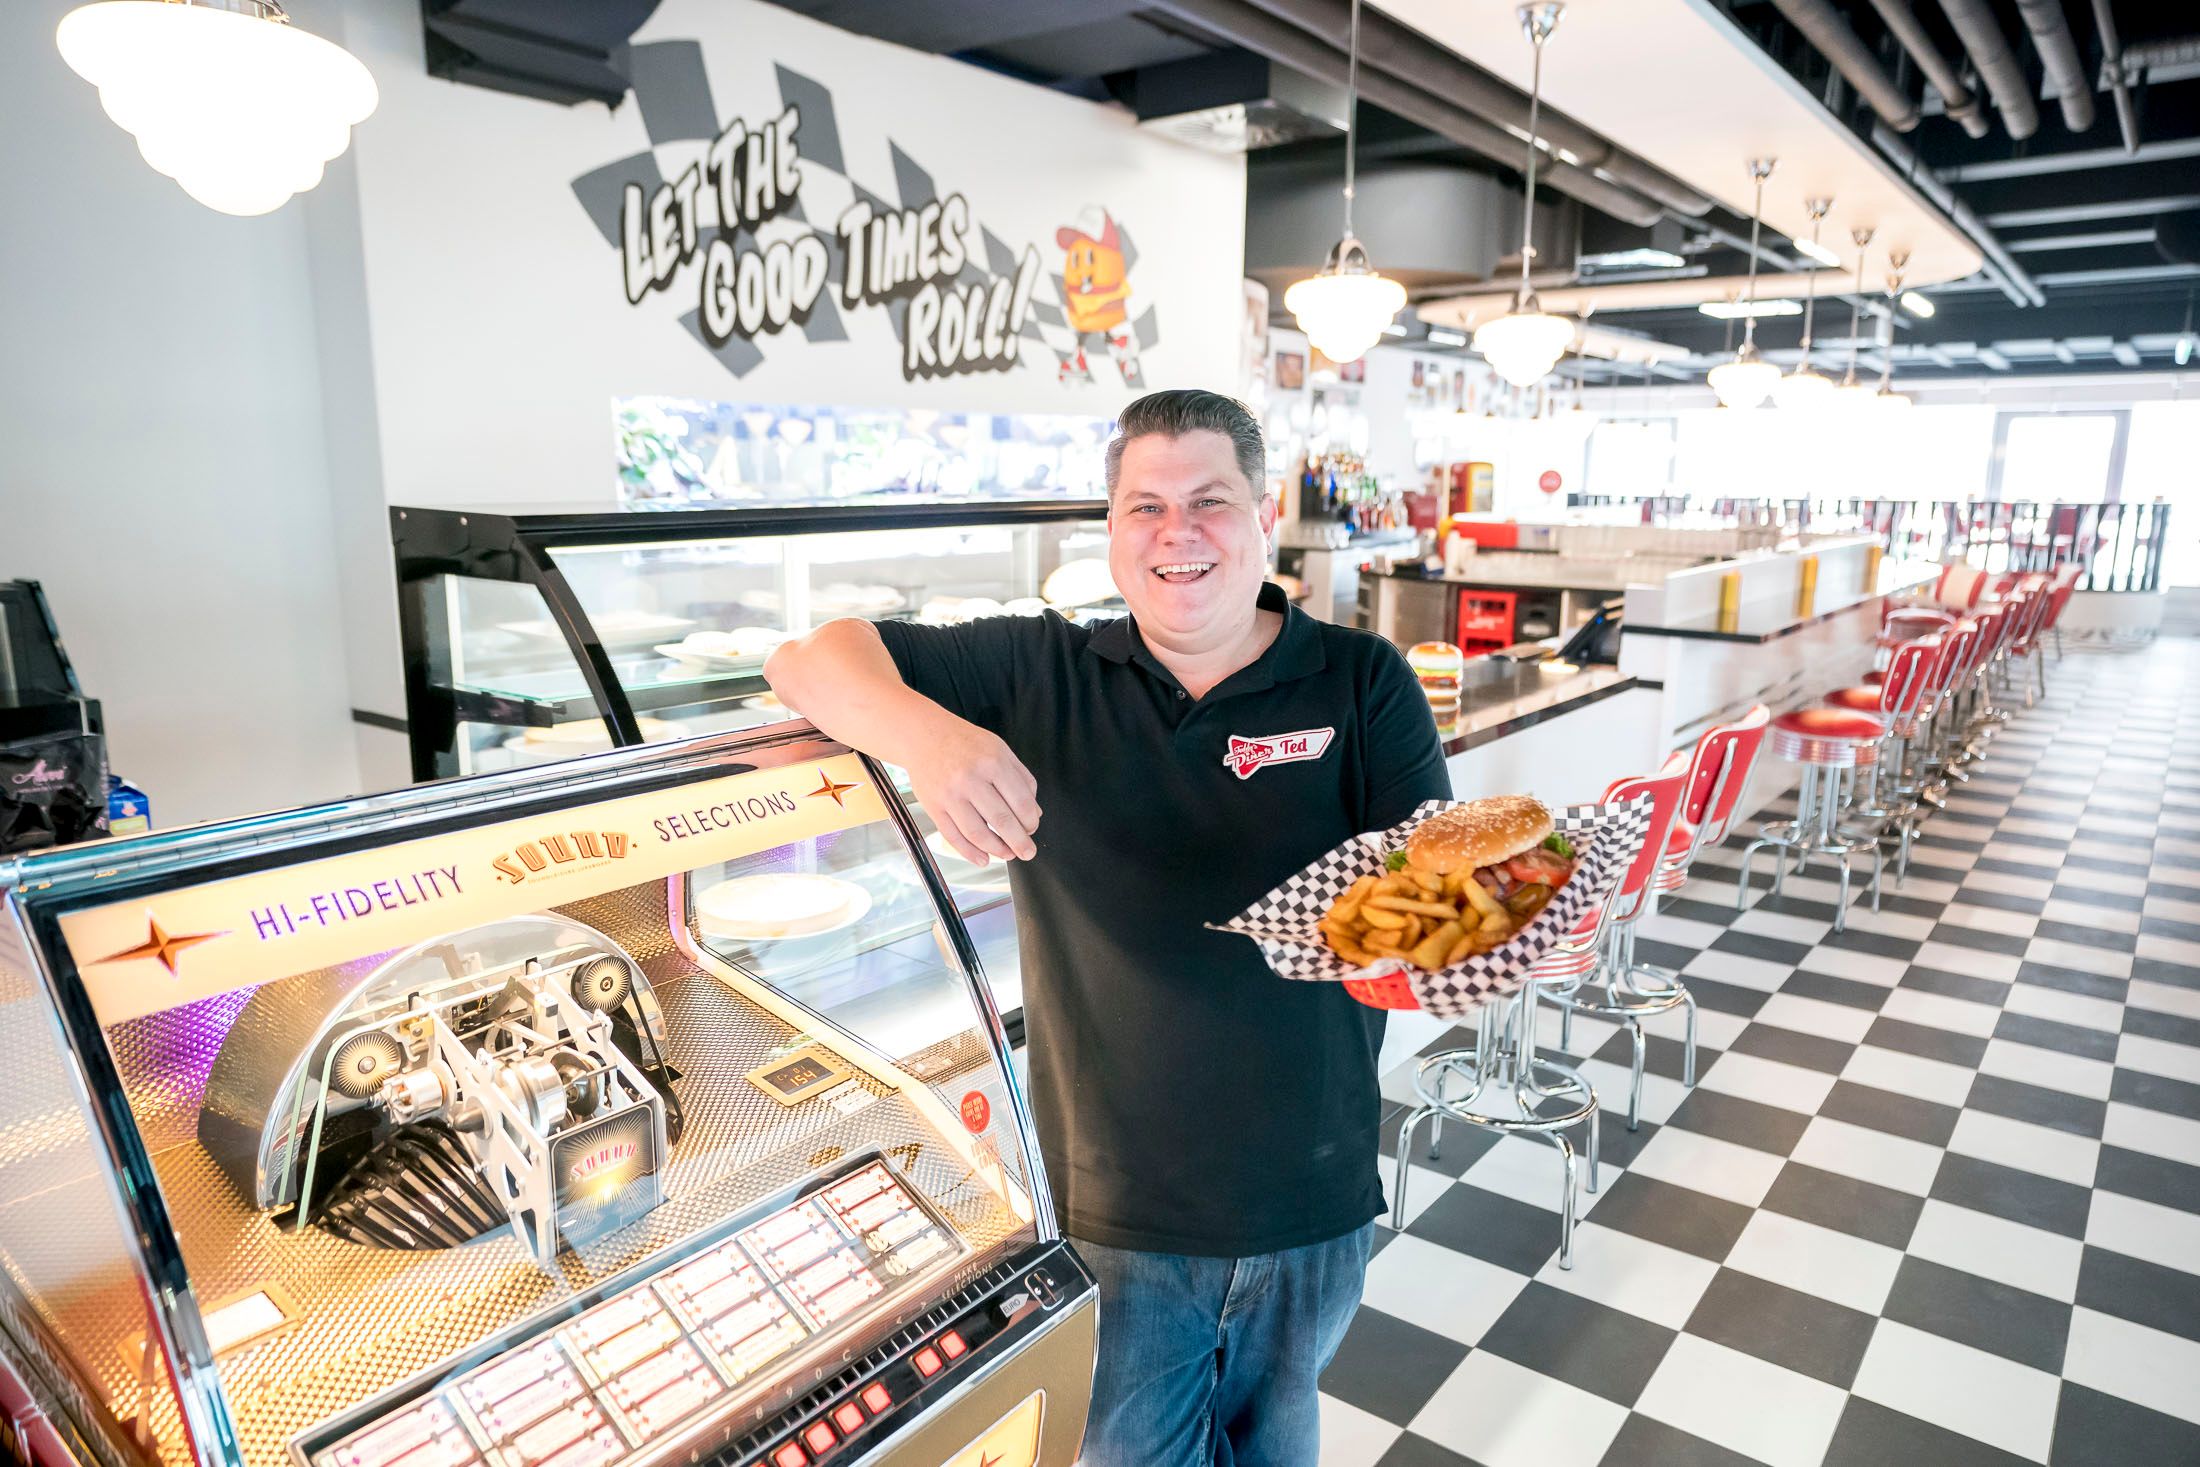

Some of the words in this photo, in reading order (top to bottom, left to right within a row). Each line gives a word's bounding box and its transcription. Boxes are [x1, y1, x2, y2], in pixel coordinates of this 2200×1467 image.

[623, 157, 702, 305] LET
[708, 103, 802, 236] THE
[700, 236, 829, 347] GOOD
[837, 192, 968, 311] TIMES
[903, 244, 1041, 382] ROLL!
[1230, 747, 1273, 768] Diner
[1280, 738, 1308, 754] Ted
[653, 790, 797, 842] SELECTIONS
[492, 831, 629, 884] SOUND
[250, 865, 465, 940] HI-FIDELITY
[790, 1070, 817, 1087] 154
[942, 1262, 993, 1300] SELECTIONS
[954, 1262, 978, 1283] MAKE
[1003, 1298, 1021, 1315] EURO
[755, 1405, 764, 1420] 8
[786, 1386, 793, 1400] 9
[842, 1348, 852, 1361] C
